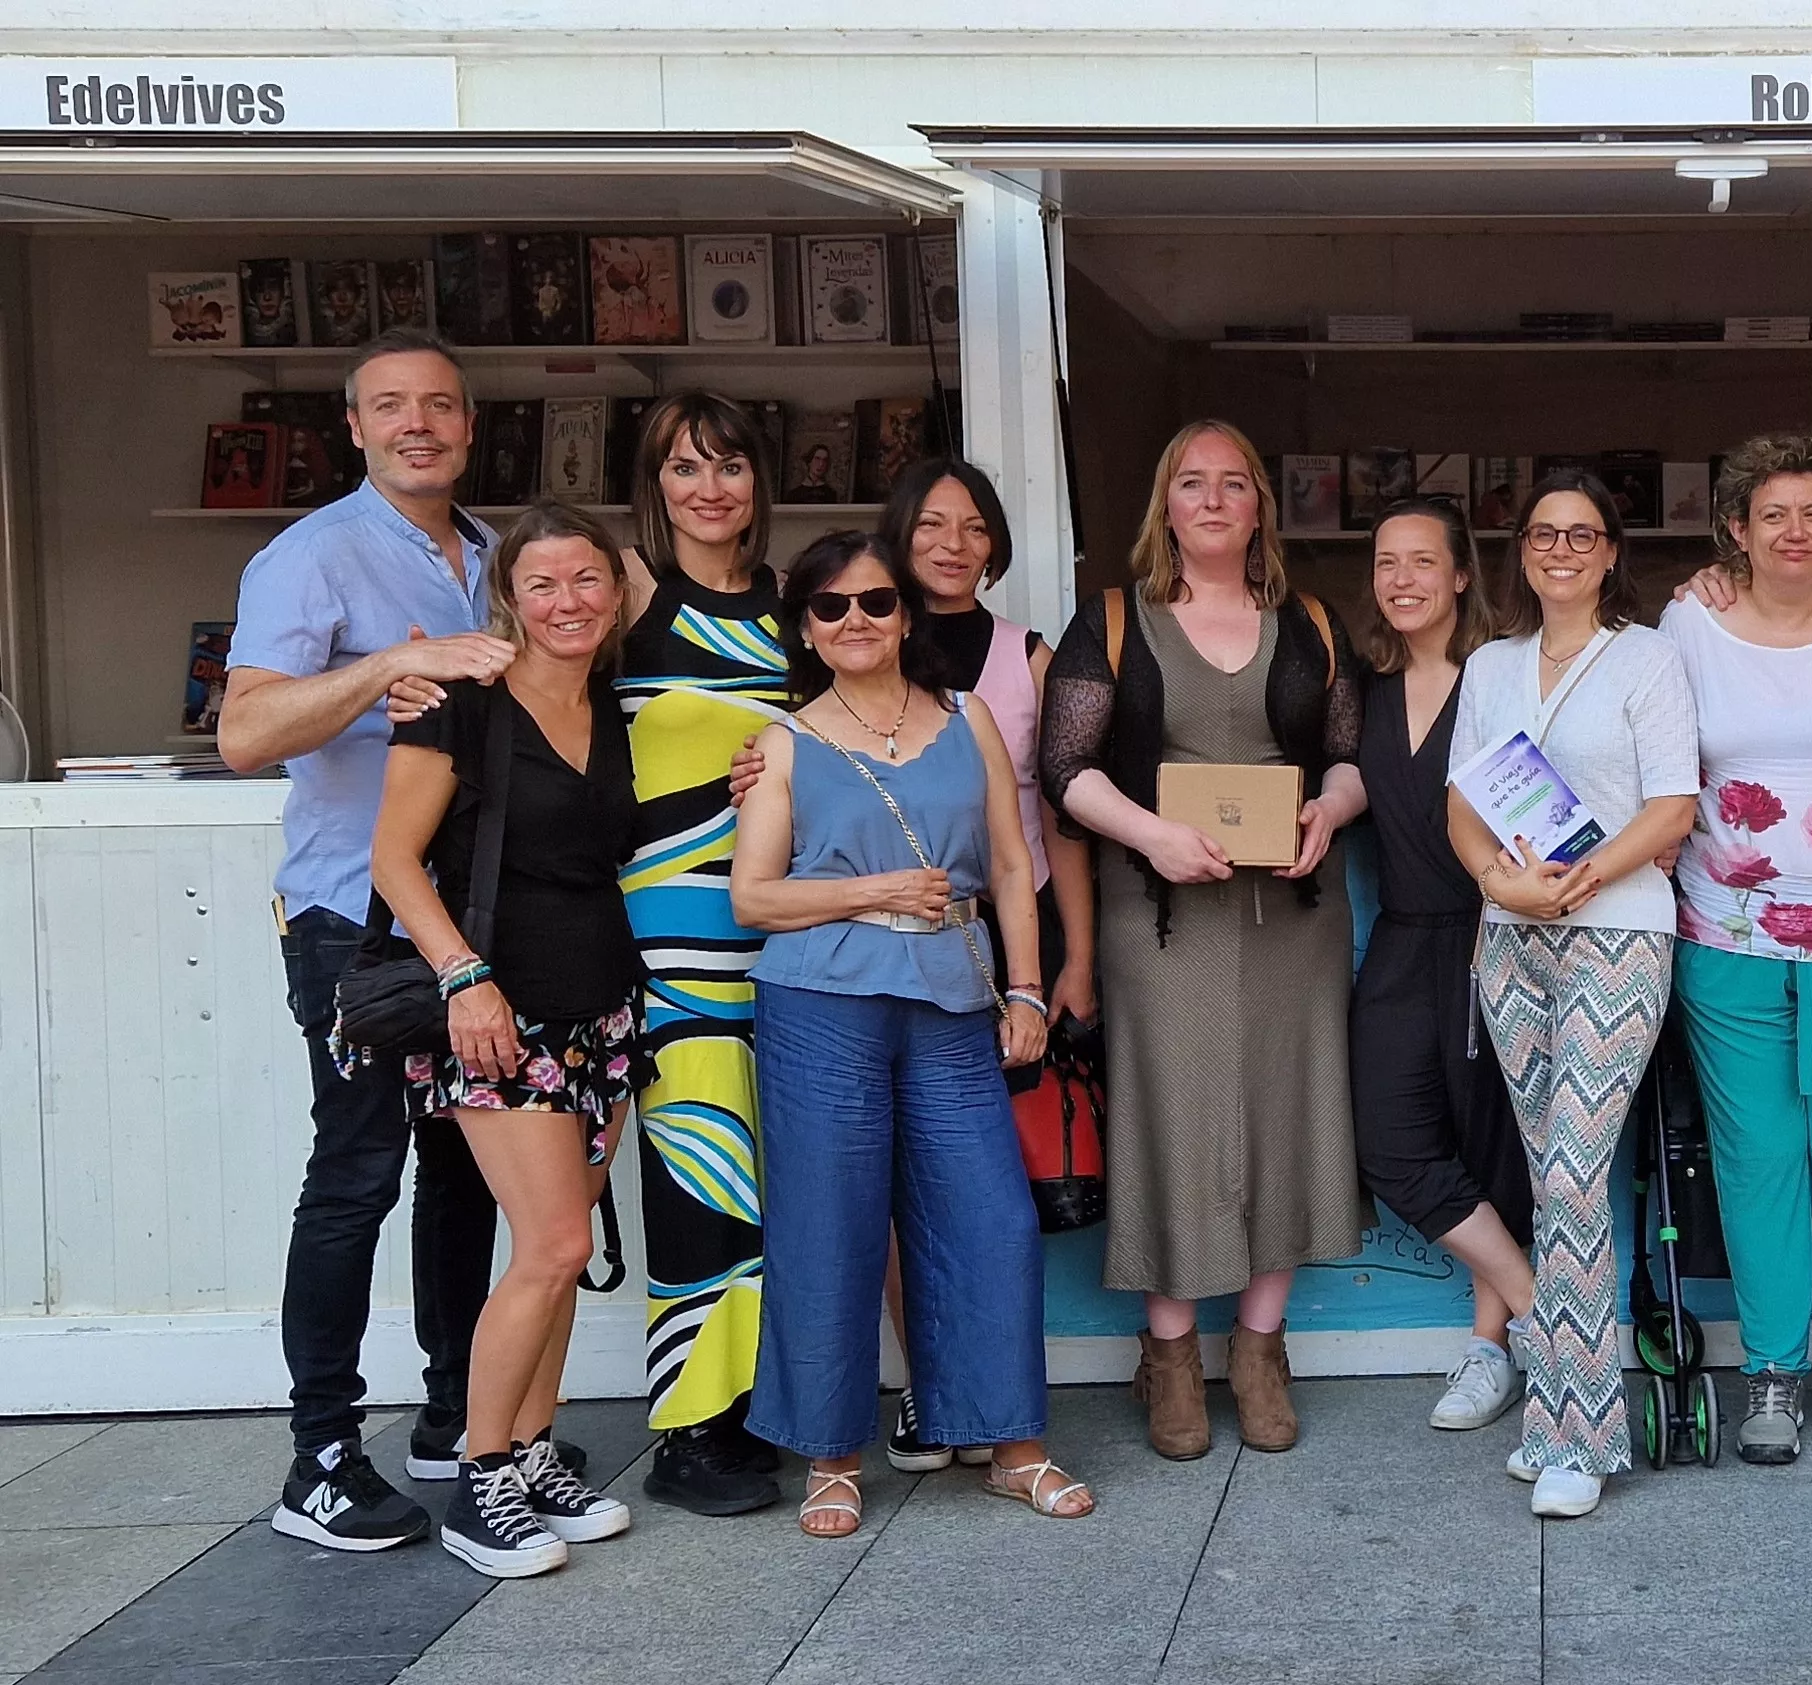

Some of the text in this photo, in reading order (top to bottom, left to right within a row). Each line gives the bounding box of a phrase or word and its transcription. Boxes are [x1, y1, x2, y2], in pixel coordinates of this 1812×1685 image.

[46, 75, 286, 125] Edelvives
[703, 249, 757, 265] ALICIA
[1491, 793, 1509, 810] que
[1507, 784, 1521, 794] te
[1521, 767, 1542, 787] guía
